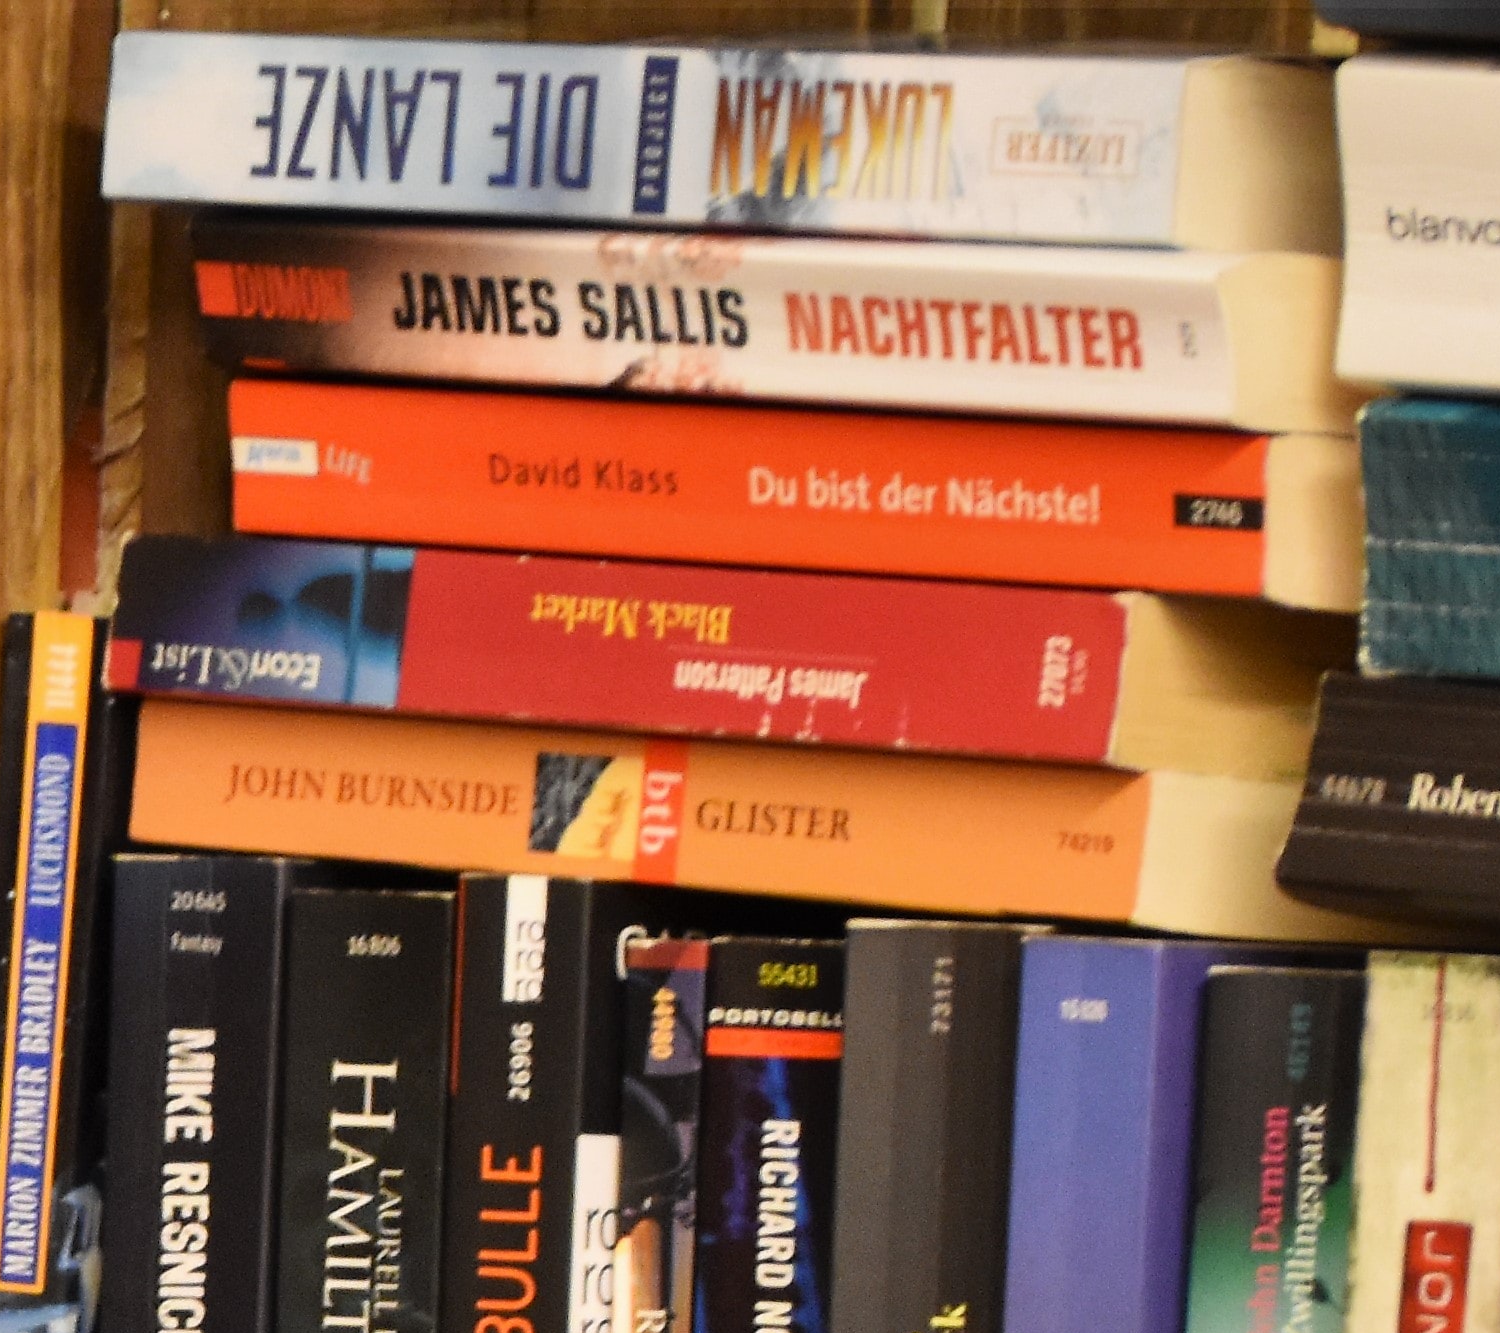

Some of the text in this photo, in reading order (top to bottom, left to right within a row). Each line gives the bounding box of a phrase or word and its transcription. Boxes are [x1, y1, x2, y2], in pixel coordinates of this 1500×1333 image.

[250, 62, 599, 191] DIE LANZE
[393, 270, 1146, 370] JAMES SALLIS NACHTFALTER
[488, 451, 1102, 529] David Klass Du bist der Nächste!
[224, 763, 853, 847] JOHN BURNSIDE GLISTER
[164, 1028, 216, 1144] MIKE
[754, 1119, 801, 1290] RICHARD
